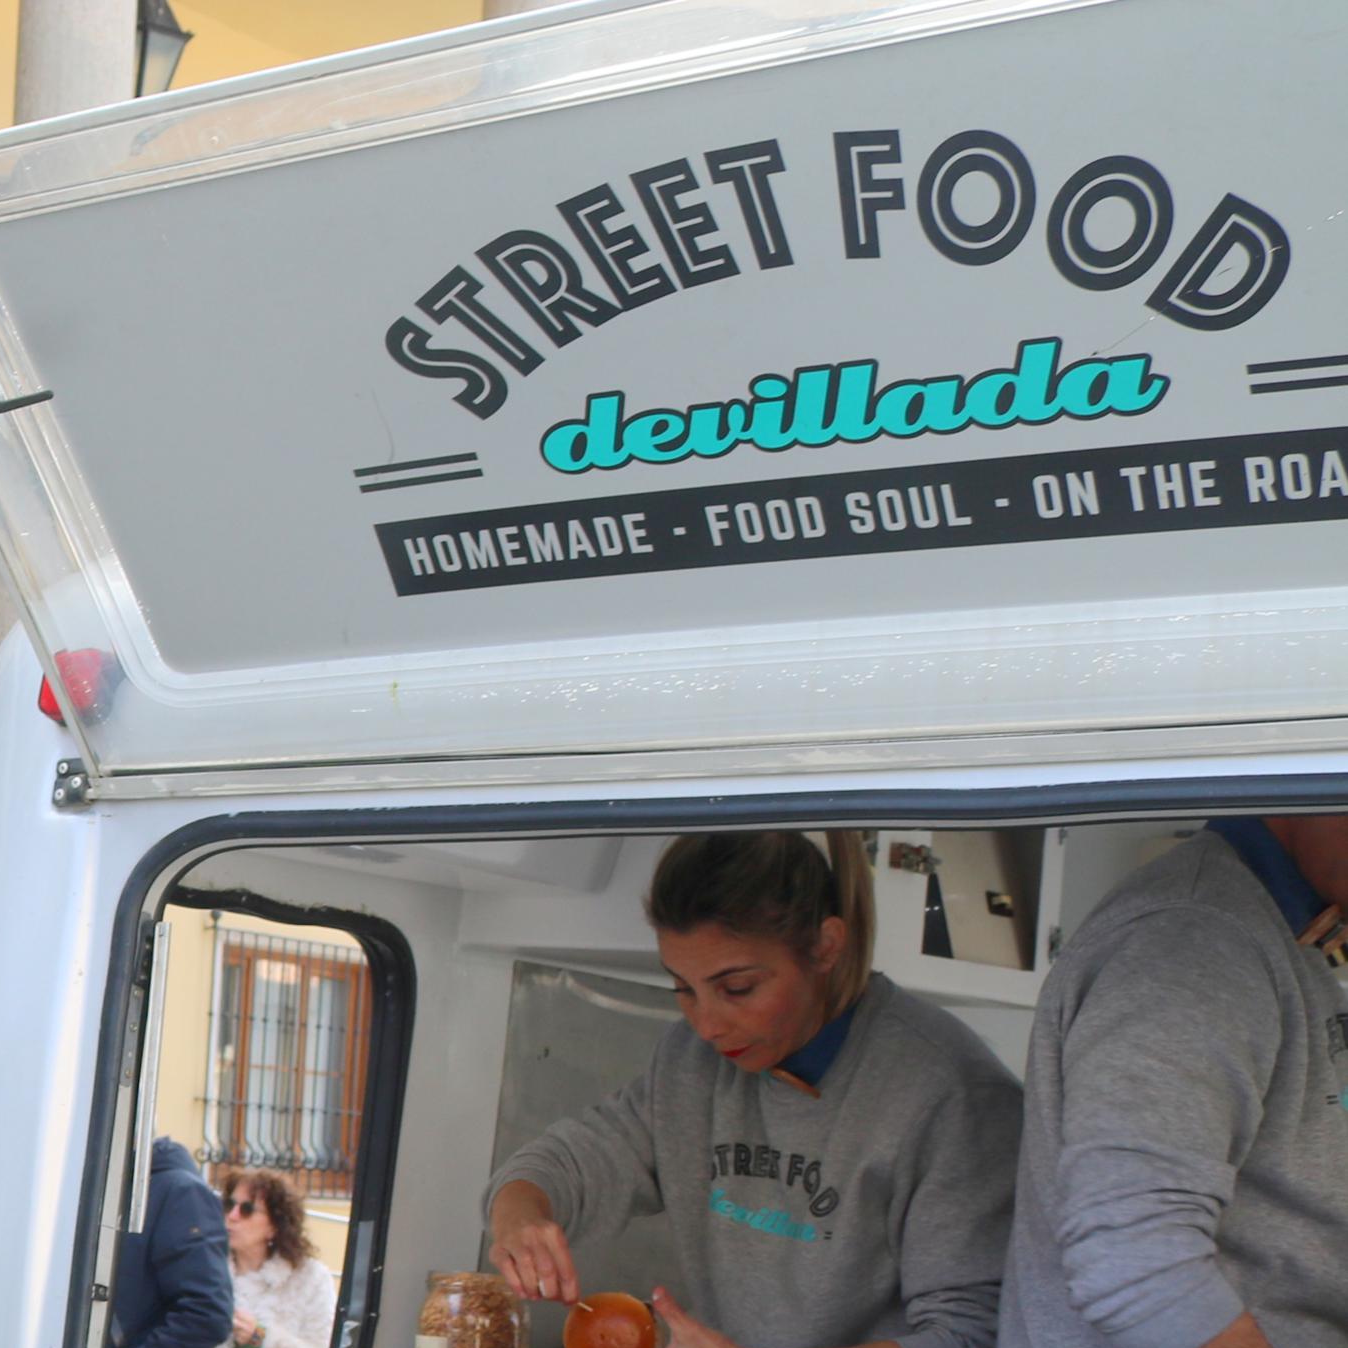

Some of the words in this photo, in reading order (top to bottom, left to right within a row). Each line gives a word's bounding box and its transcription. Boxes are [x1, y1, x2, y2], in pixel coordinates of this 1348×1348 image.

[385, 138, 795, 421] STREET
[832, 129, 1291, 332] FOOD
[539, 335, 1171, 474] devillada
[403, 512, 654, 577] HOMEMADE
[704, 496, 827, 547] FOOD
[845, 483, 973, 535] SOUL
[1032, 470, 1101, 520] ON
[1119, 459, 1222, 512] THE
[786, 1153, 840, 1218] FOD
